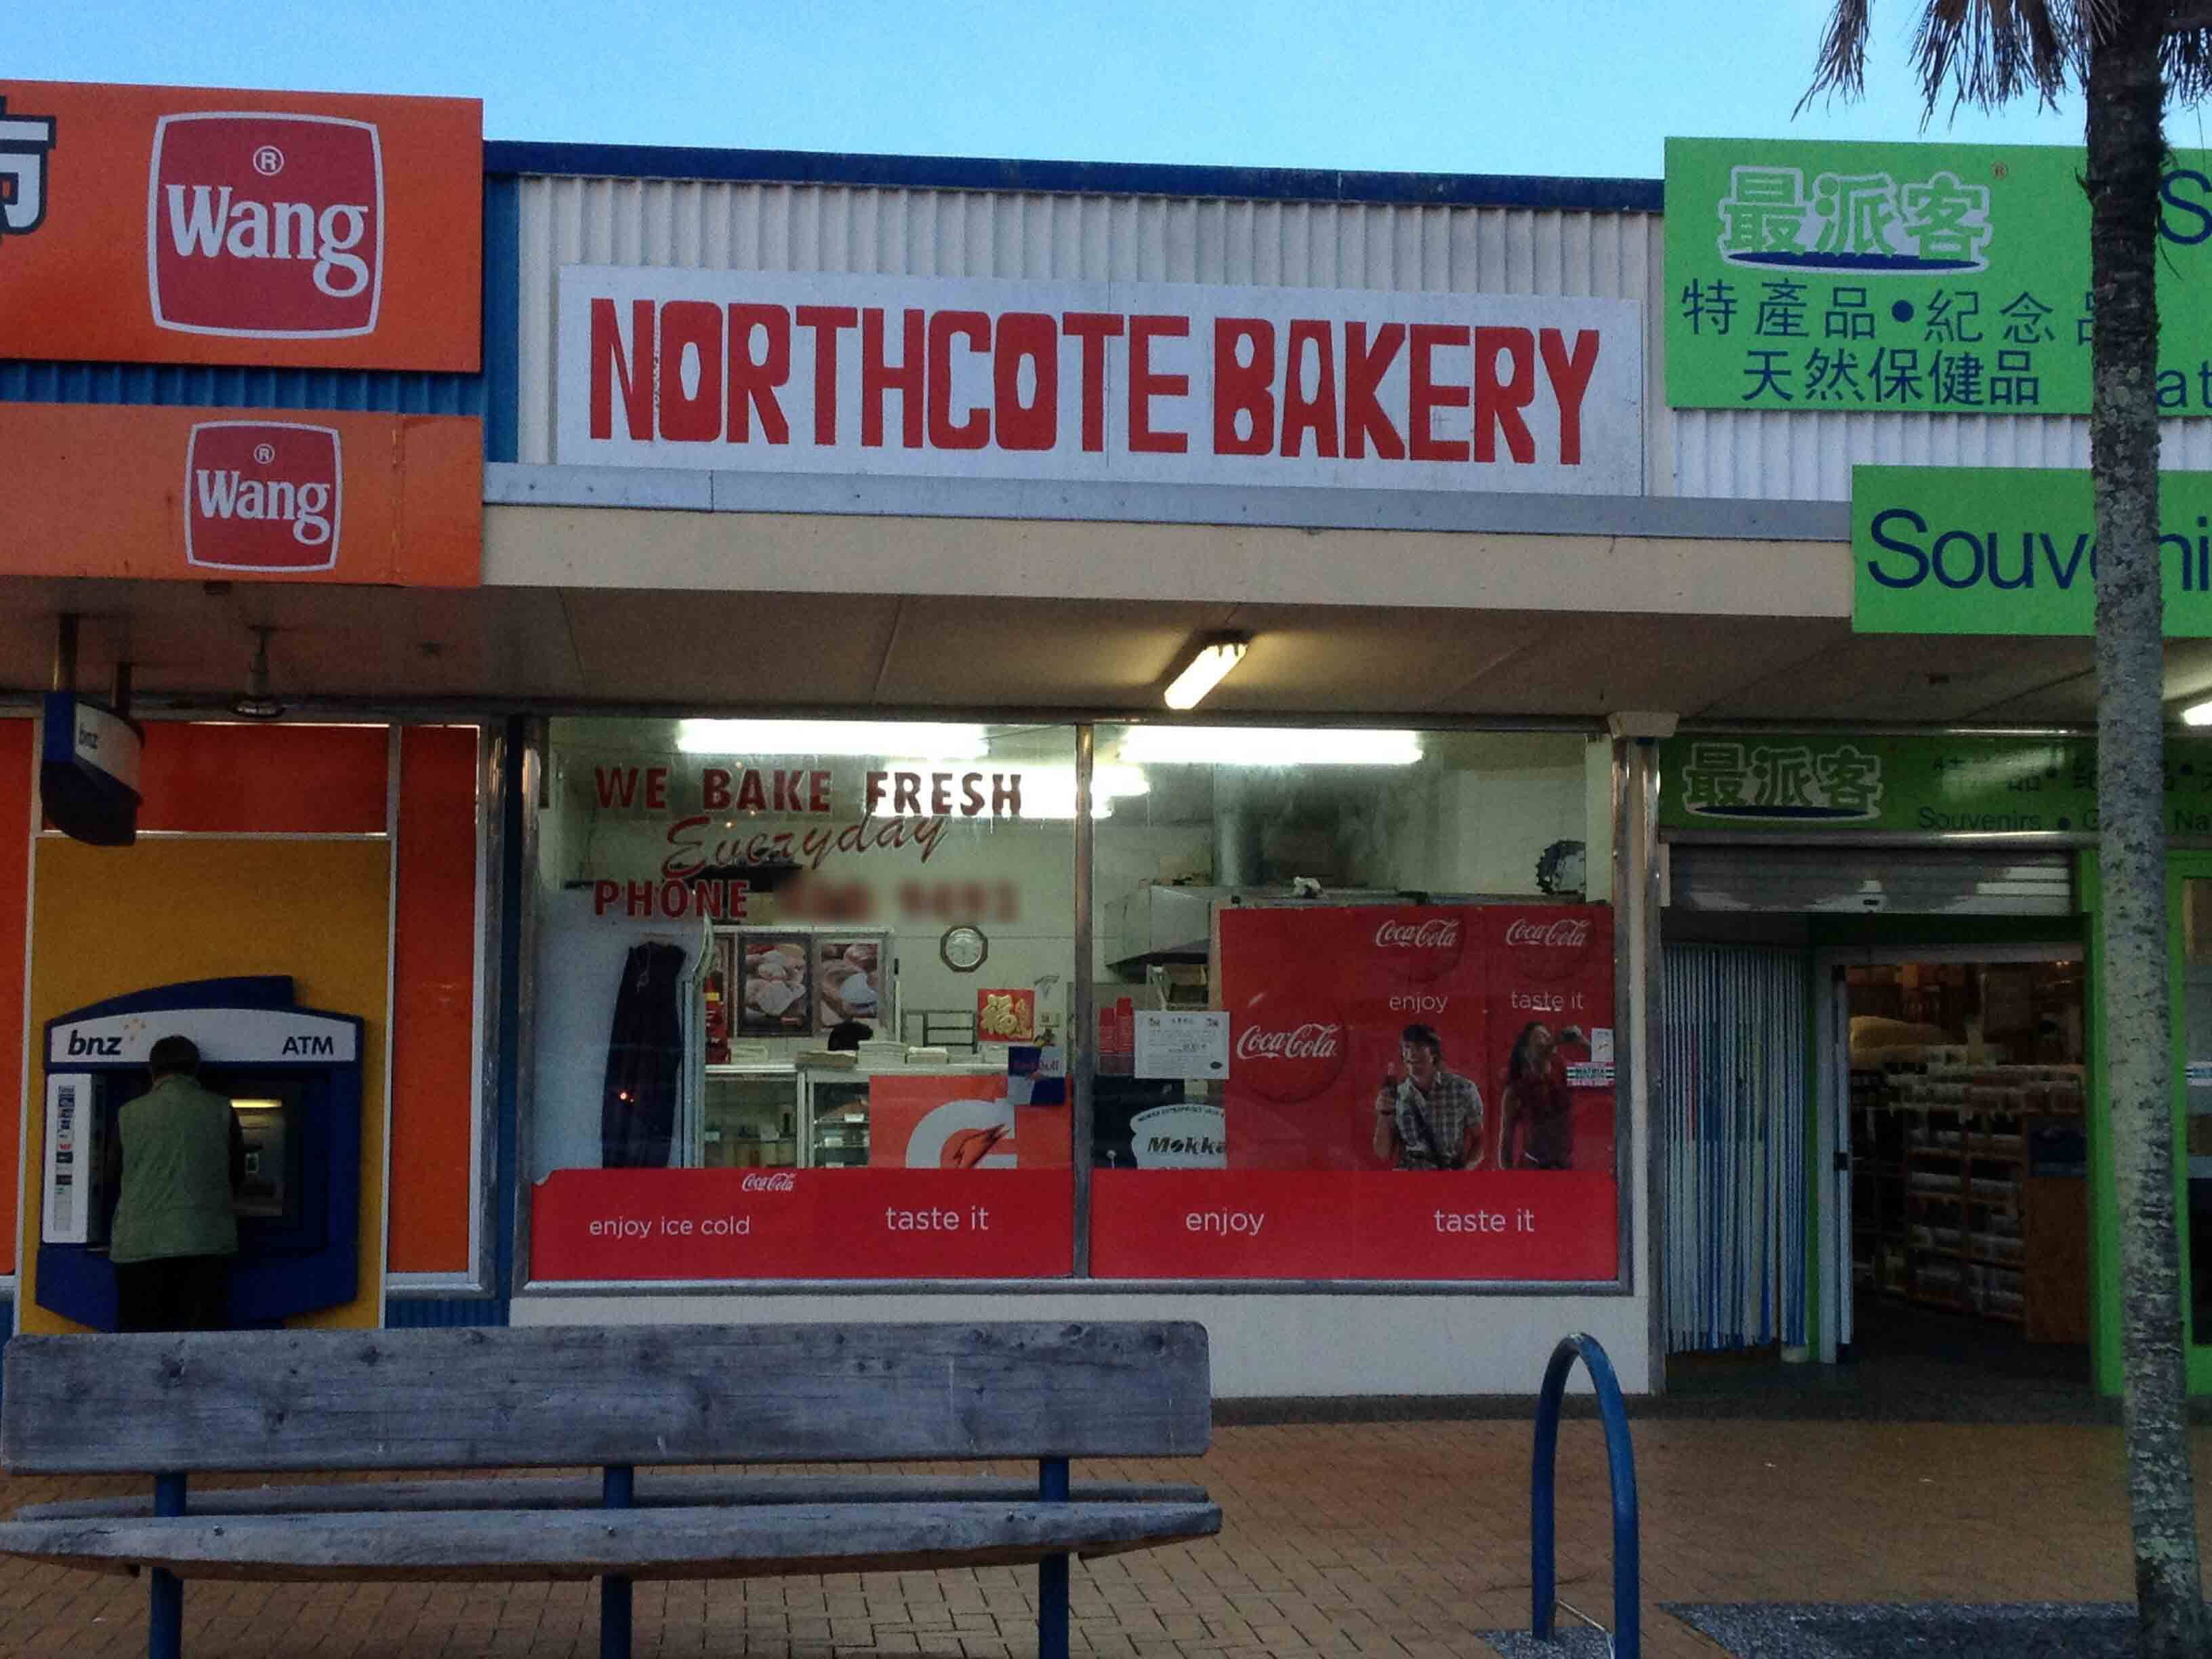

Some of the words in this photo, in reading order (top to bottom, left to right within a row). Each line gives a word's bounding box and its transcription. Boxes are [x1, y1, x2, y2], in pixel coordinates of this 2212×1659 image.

[1717, 164, 1994, 268] 最派客
[165, 184, 369, 298] Wang
[590, 297, 1189, 455] NORTHCOTE
[1213, 316, 1601, 466] BAKERY
[1741, 346, 2040, 407] 天然保健品
[196, 468, 331, 545] Wang
[594, 766, 668, 809] WE
[702, 768, 832, 812] BAKE
[865, 771, 1023, 815] FRESH
[1682, 743, 1884, 813] 最派客
[1919, 806, 2041, 832] Souvenirs
[661, 814, 950, 880] Everyday
[594, 879, 750, 918] PHONE
[1375, 919, 1460, 948] Coca-Cola
[1505, 918, 1591, 947] Coca-Cola
[1389, 994, 1449, 1015] enjoy
[1511, 991, 1563, 1010] taste
[1571, 994, 1584, 1010] it
[68, 1029, 123, 1055] bnz
[282, 1036, 335, 1055] ATM
[1236, 1024, 1341, 1060] Coca-Cola
[741, 1172, 796, 1193] Coca-Cola
[589, 1216, 652, 1238] enjoy
[660, 1216, 693, 1235] ice
[701, 1215, 751, 1235] cold
[885, 1206, 960, 1231] taste
[970, 1205, 989, 1231] it
[1185, 1209, 1265, 1236] enjoy
[1434, 1208, 1506, 1233] taste
[1517, 1208, 1535, 1233] it
